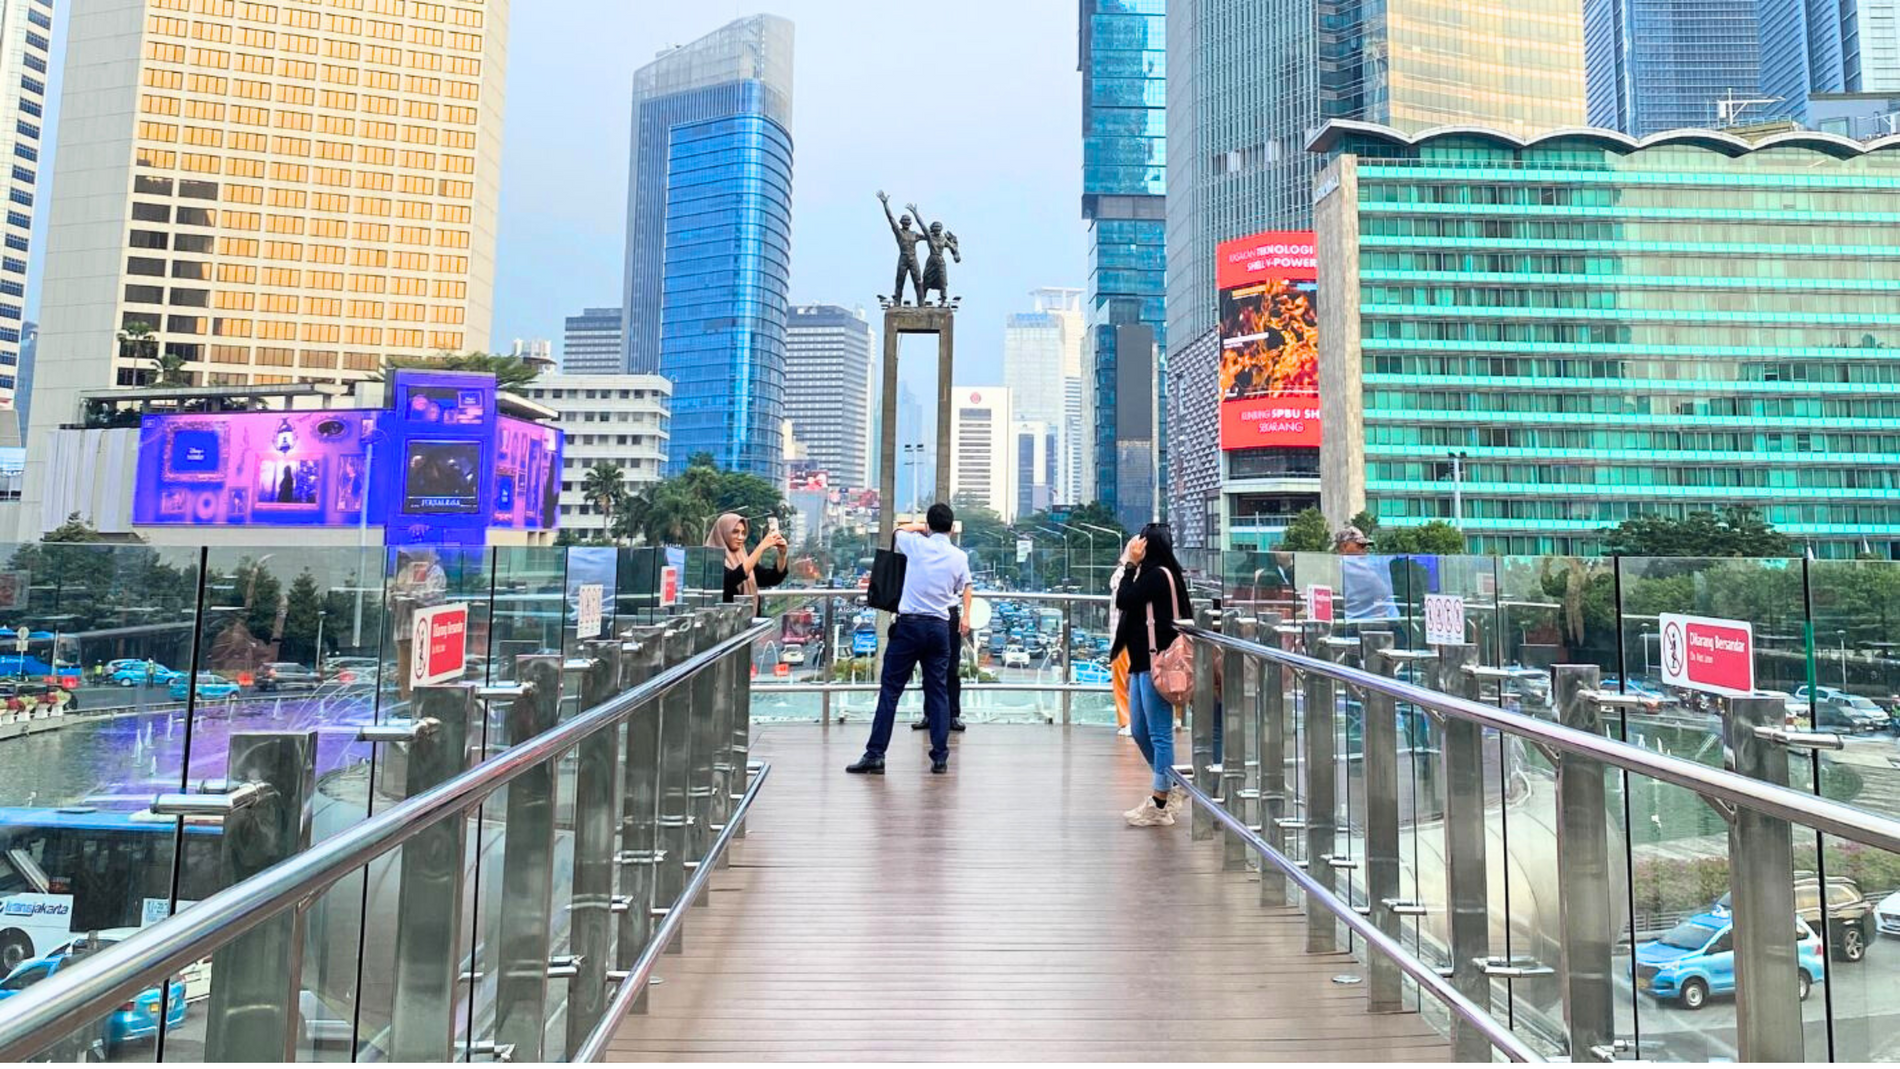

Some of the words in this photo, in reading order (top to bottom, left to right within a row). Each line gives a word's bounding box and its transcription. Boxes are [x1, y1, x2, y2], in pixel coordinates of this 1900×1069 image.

[1256, 245, 1314, 256] TEKNOLOGI
[1265, 257, 1318, 268] V-POWER
[1271, 409, 1300, 419] SPBU
[1690, 632, 1714, 651] Dilarang
[1714, 635, 1745, 652] Bersandar
[5, 900, 69, 917] transjakarta
